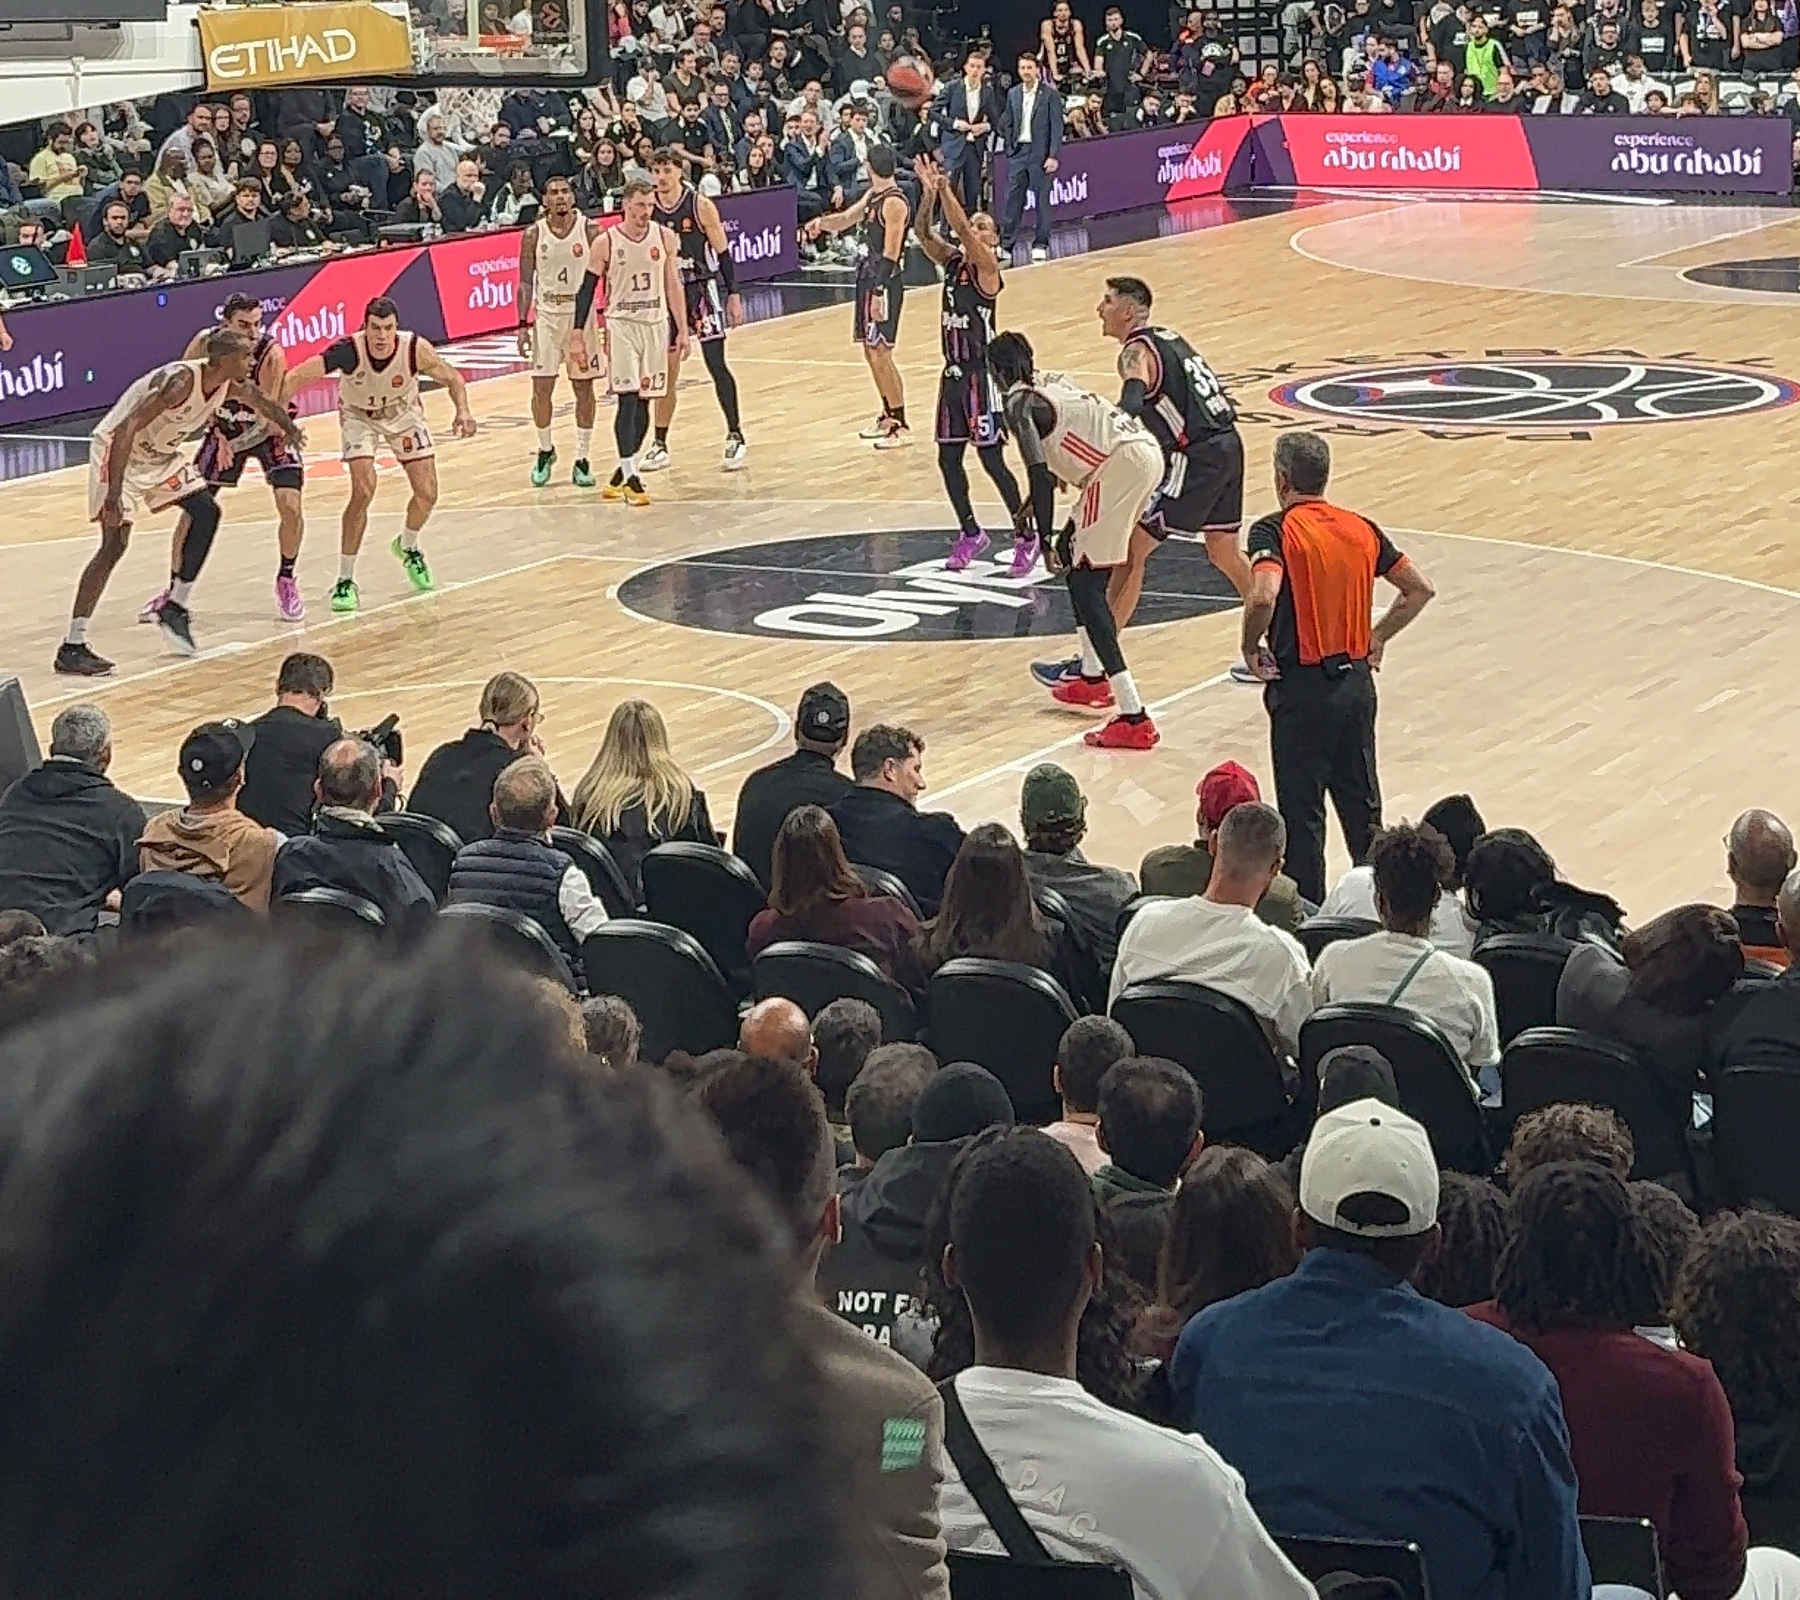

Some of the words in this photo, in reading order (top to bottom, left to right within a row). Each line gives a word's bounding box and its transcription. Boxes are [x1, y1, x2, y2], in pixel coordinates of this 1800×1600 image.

[209, 28, 358, 79] ETIHAD
[1614, 132, 1694, 148] experience
[558, 267, 568, 285] 4
[631, 272, 652, 292] 13
[590, 354, 601, 371] 4
[651, 373, 666, 391] 13
[978, 414, 991, 437] 5
[837, 1290, 888, 1314] NOT
